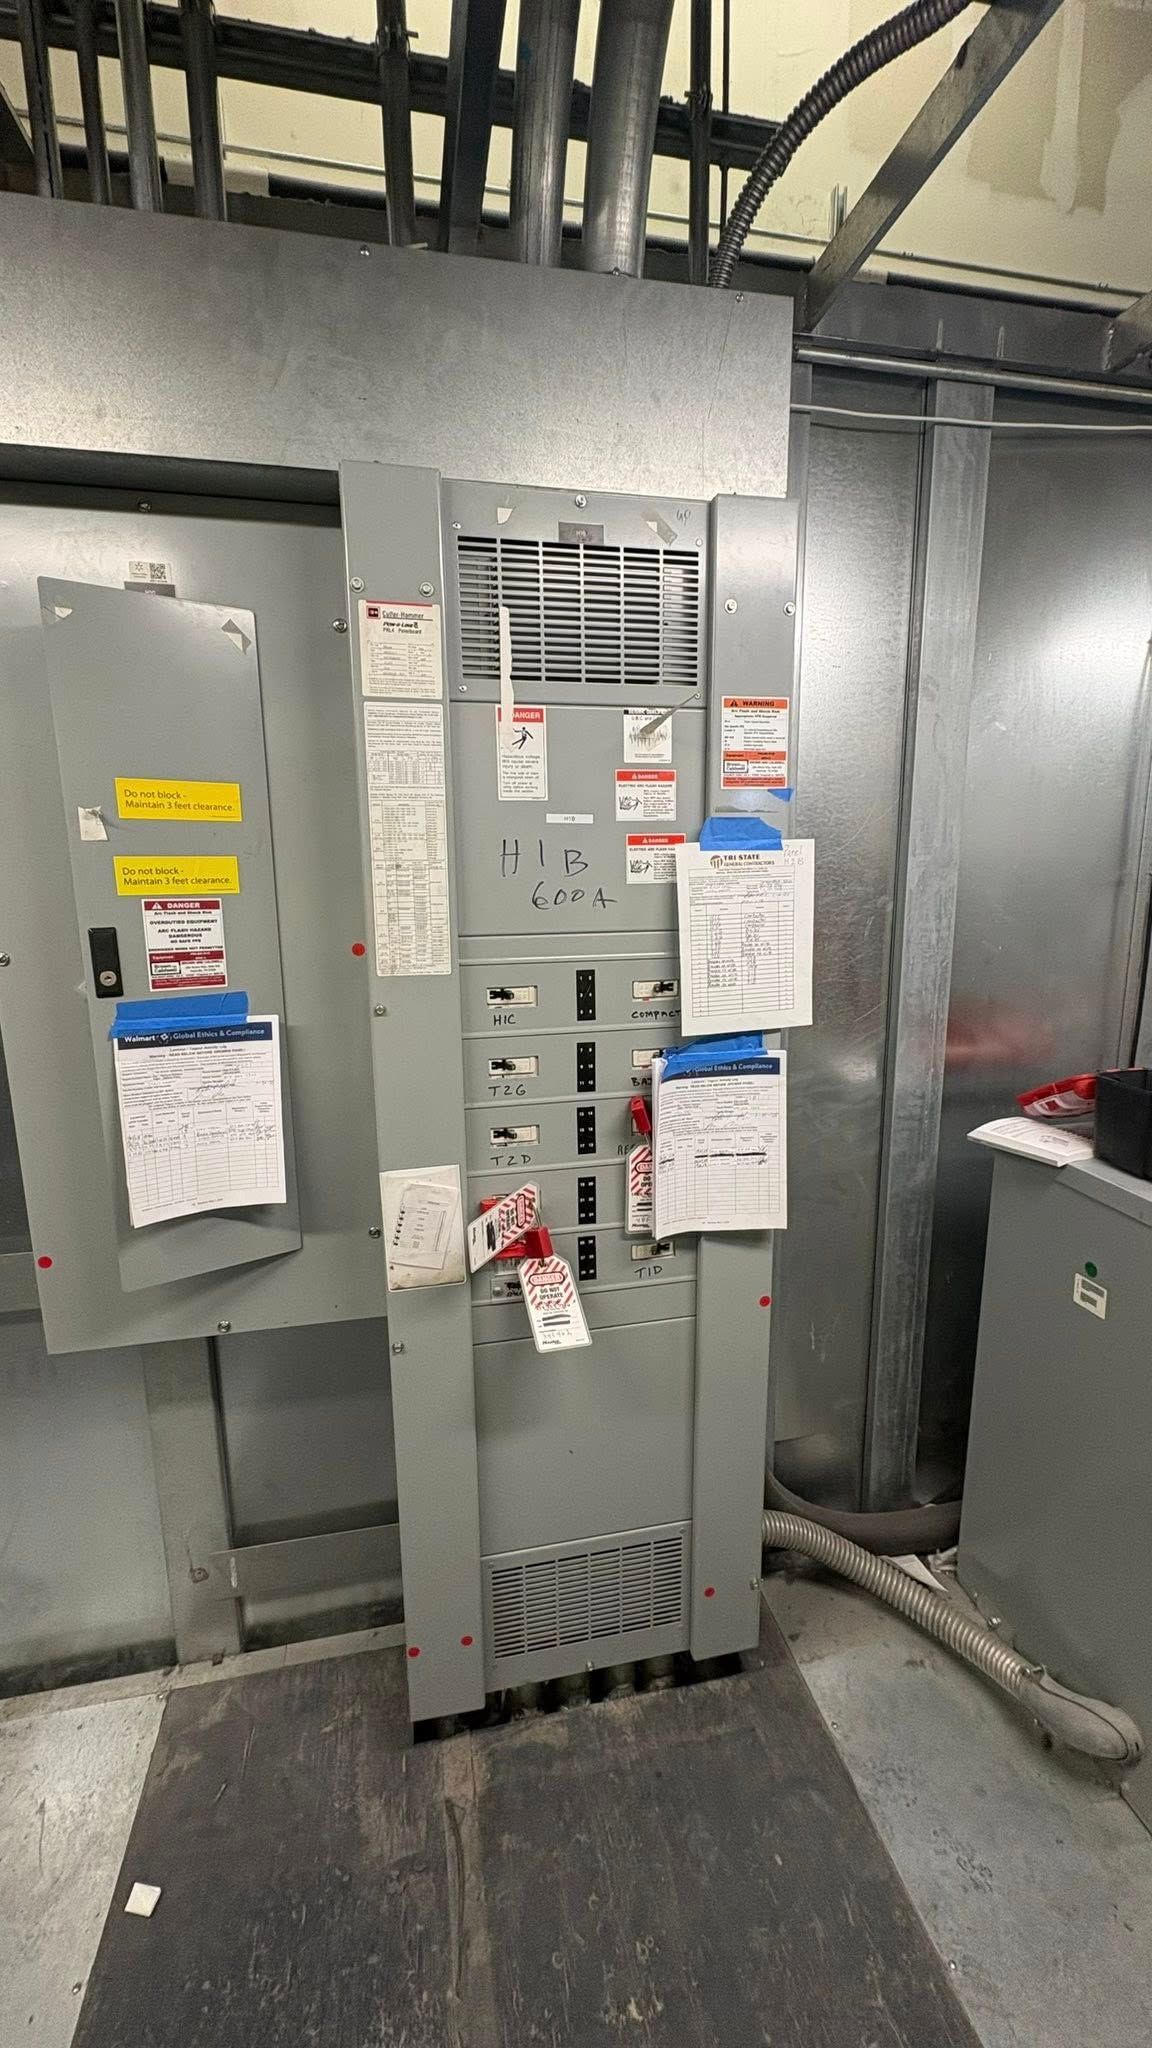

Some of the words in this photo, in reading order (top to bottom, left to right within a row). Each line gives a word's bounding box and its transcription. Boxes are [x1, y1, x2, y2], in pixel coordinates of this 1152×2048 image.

[512, 711, 541, 719] ANGER
[124, 789, 138, 799] Do
[140, 790, 155, 799] not
[157, 789, 182, 799] block
[125, 800, 165, 810] Maintain
[167, 801, 173, 810] 3
[174, 801, 192, 810] feet
[192, 802, 235, 811] clearance.
[122, 867, 136, 876] Do
[138, 867, 153, 875] not
[155, 866, 179, 875] block
[123, 877, 163, 886] Maintain
[165, 877, 170, 885] 3
[172, 877, 189, 885] feet
[190, 877, 232, 885] clearance.
[124, 1034, 156, 1043] Walmart
[172, 1032, 196, 1041] Global
[199, 1031, 218, 1039] Ethics
[226, 1029, 265, 1038] Compliance
